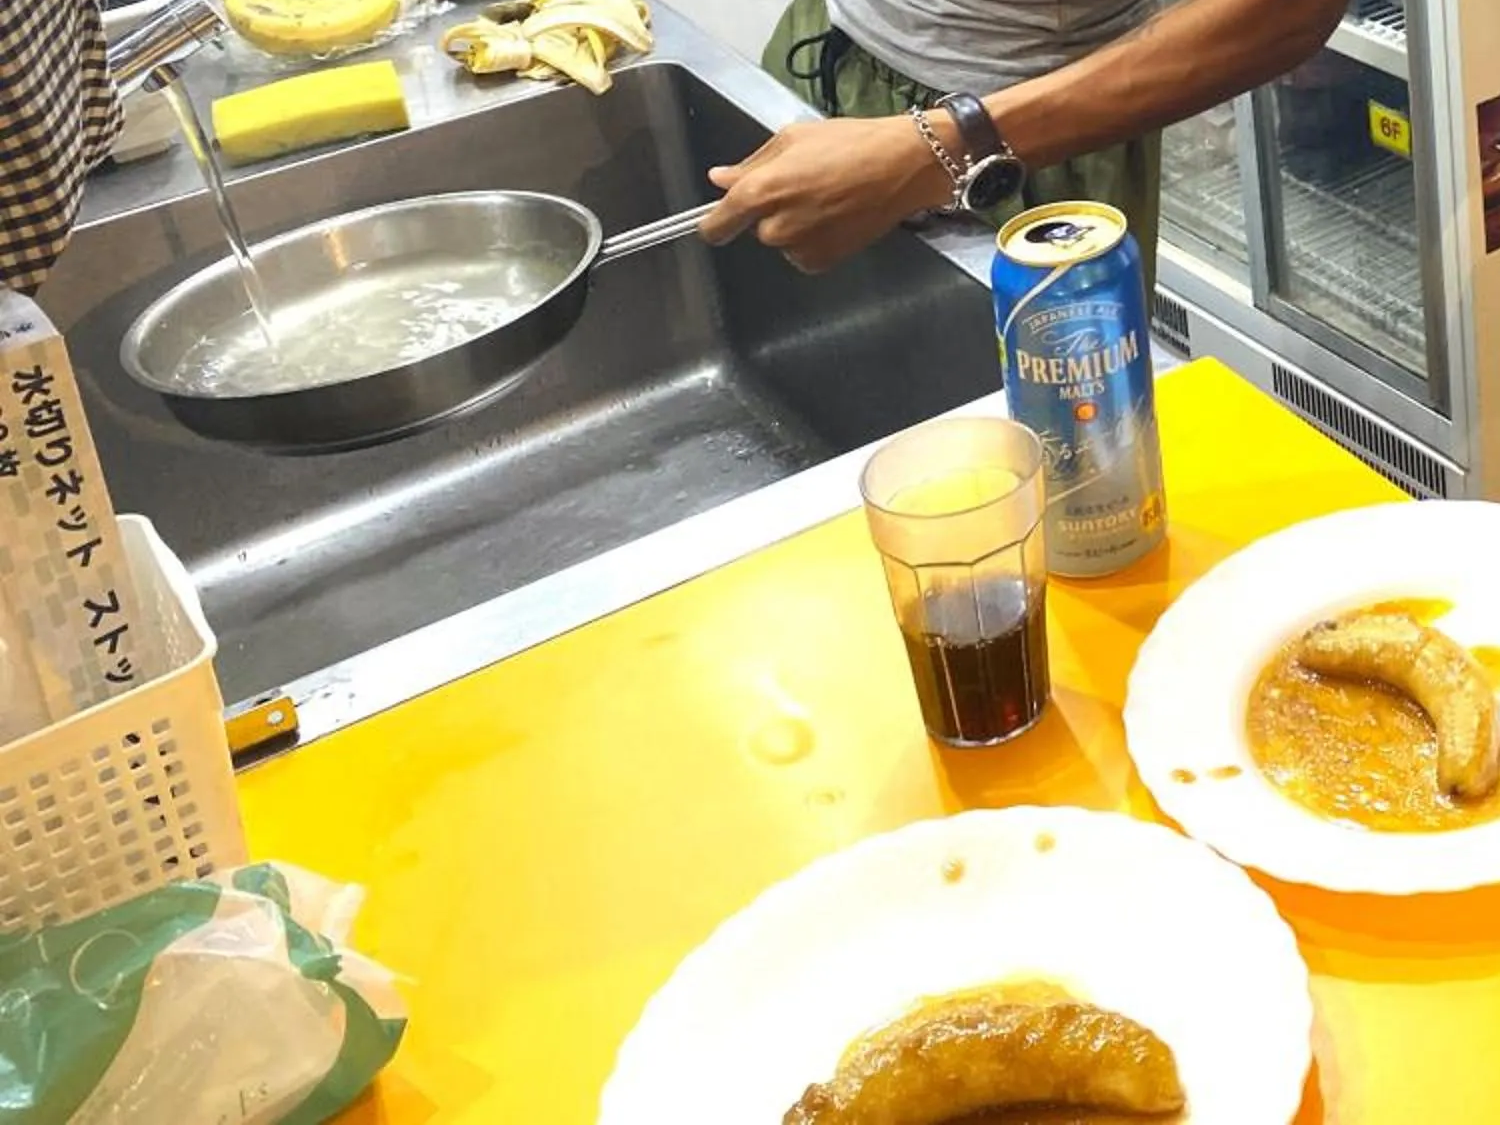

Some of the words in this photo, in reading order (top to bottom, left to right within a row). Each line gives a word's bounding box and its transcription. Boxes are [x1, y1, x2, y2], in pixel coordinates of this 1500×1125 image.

[1380, 117, 1402, 140] 6F
[1015, 330, 1139, 385] PREMIUM
[11, 364, 103, 567] 水切りネット
